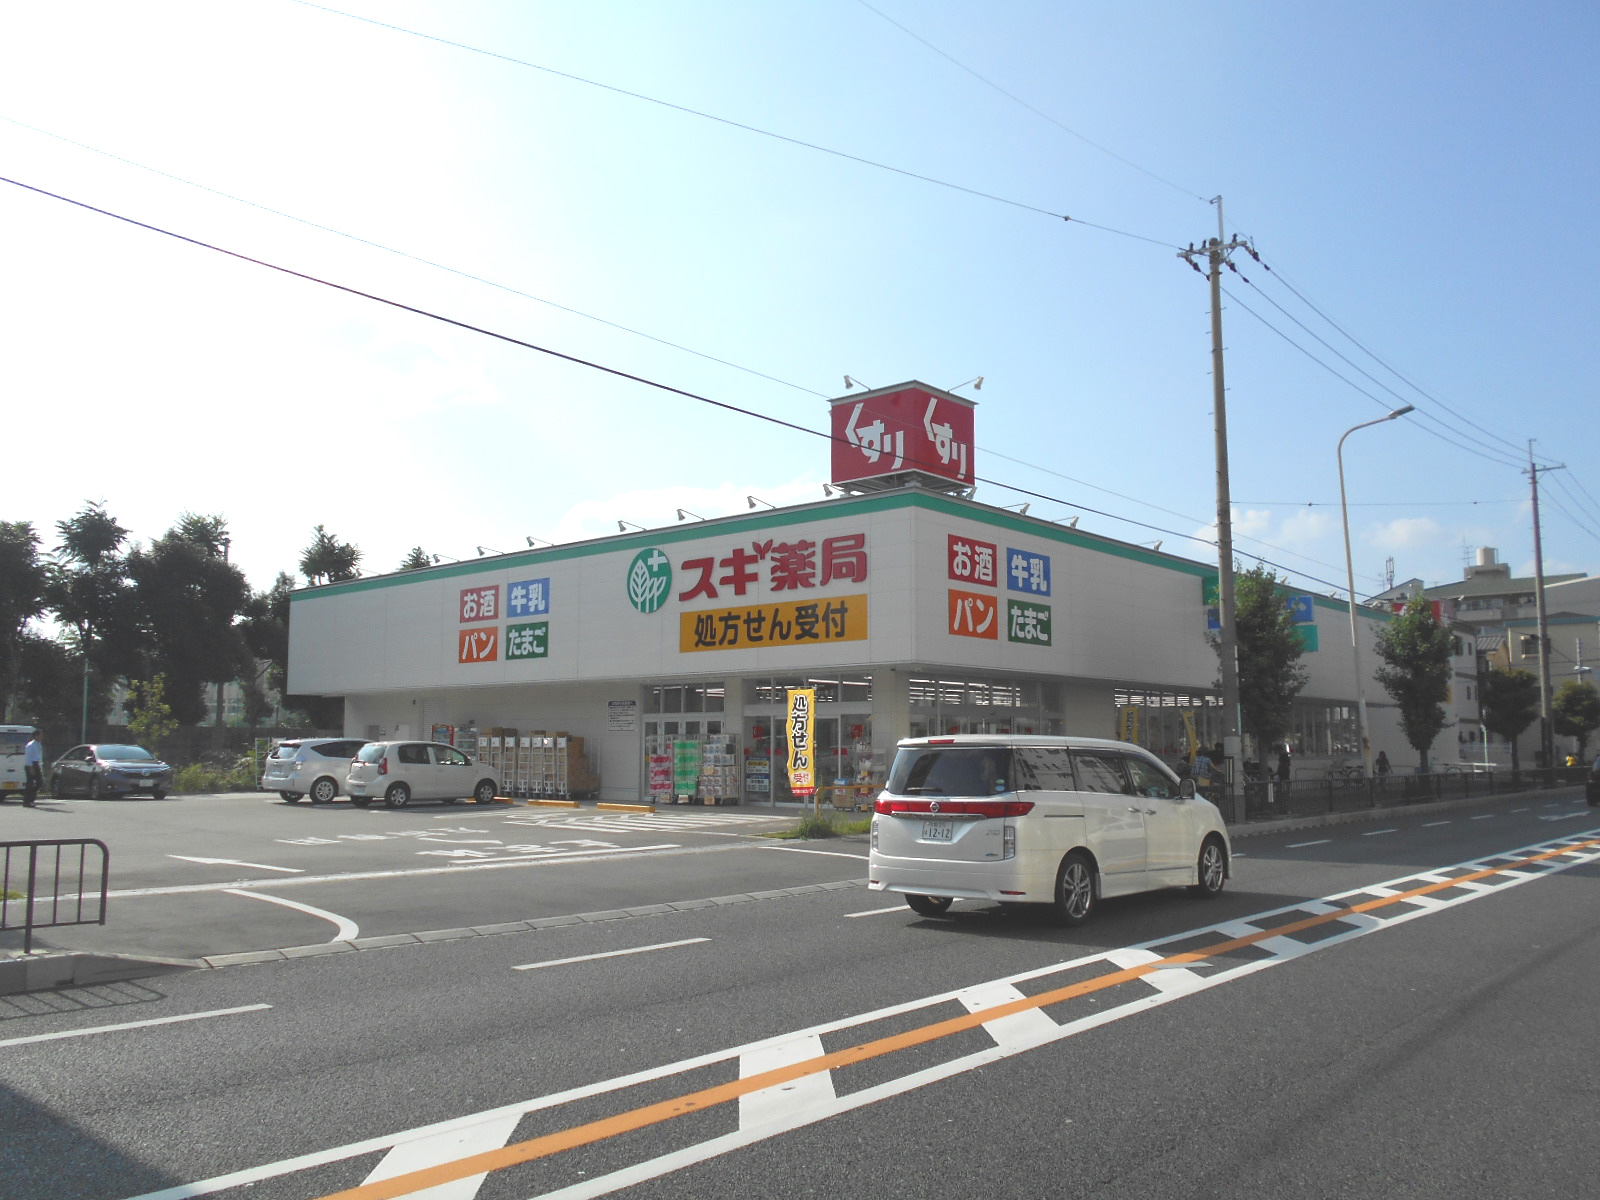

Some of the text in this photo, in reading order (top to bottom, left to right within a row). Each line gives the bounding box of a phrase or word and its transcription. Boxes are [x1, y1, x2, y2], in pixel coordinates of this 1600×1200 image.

[845, 402, 904, 470] くすり
[924, 398, 967, 480] くすり
[679, 533, 868, 601] スギ薬局
[953, 541, 993, 582] お酒
[1011, 554, 1047, 592] 牛乳
[463, 589, 496, 619] お酒
[511, 583, 546, 614] 牛乳
[953, 597, 994, 634] パン
[508, 627, 546, 656] たまご
[694, 600, 848, 648] 処方せん受付
[1011, 605, 1049, 641] たまご
[462, 632, 495, 660] パン
[791, 694, 808, 770] 処方せん
